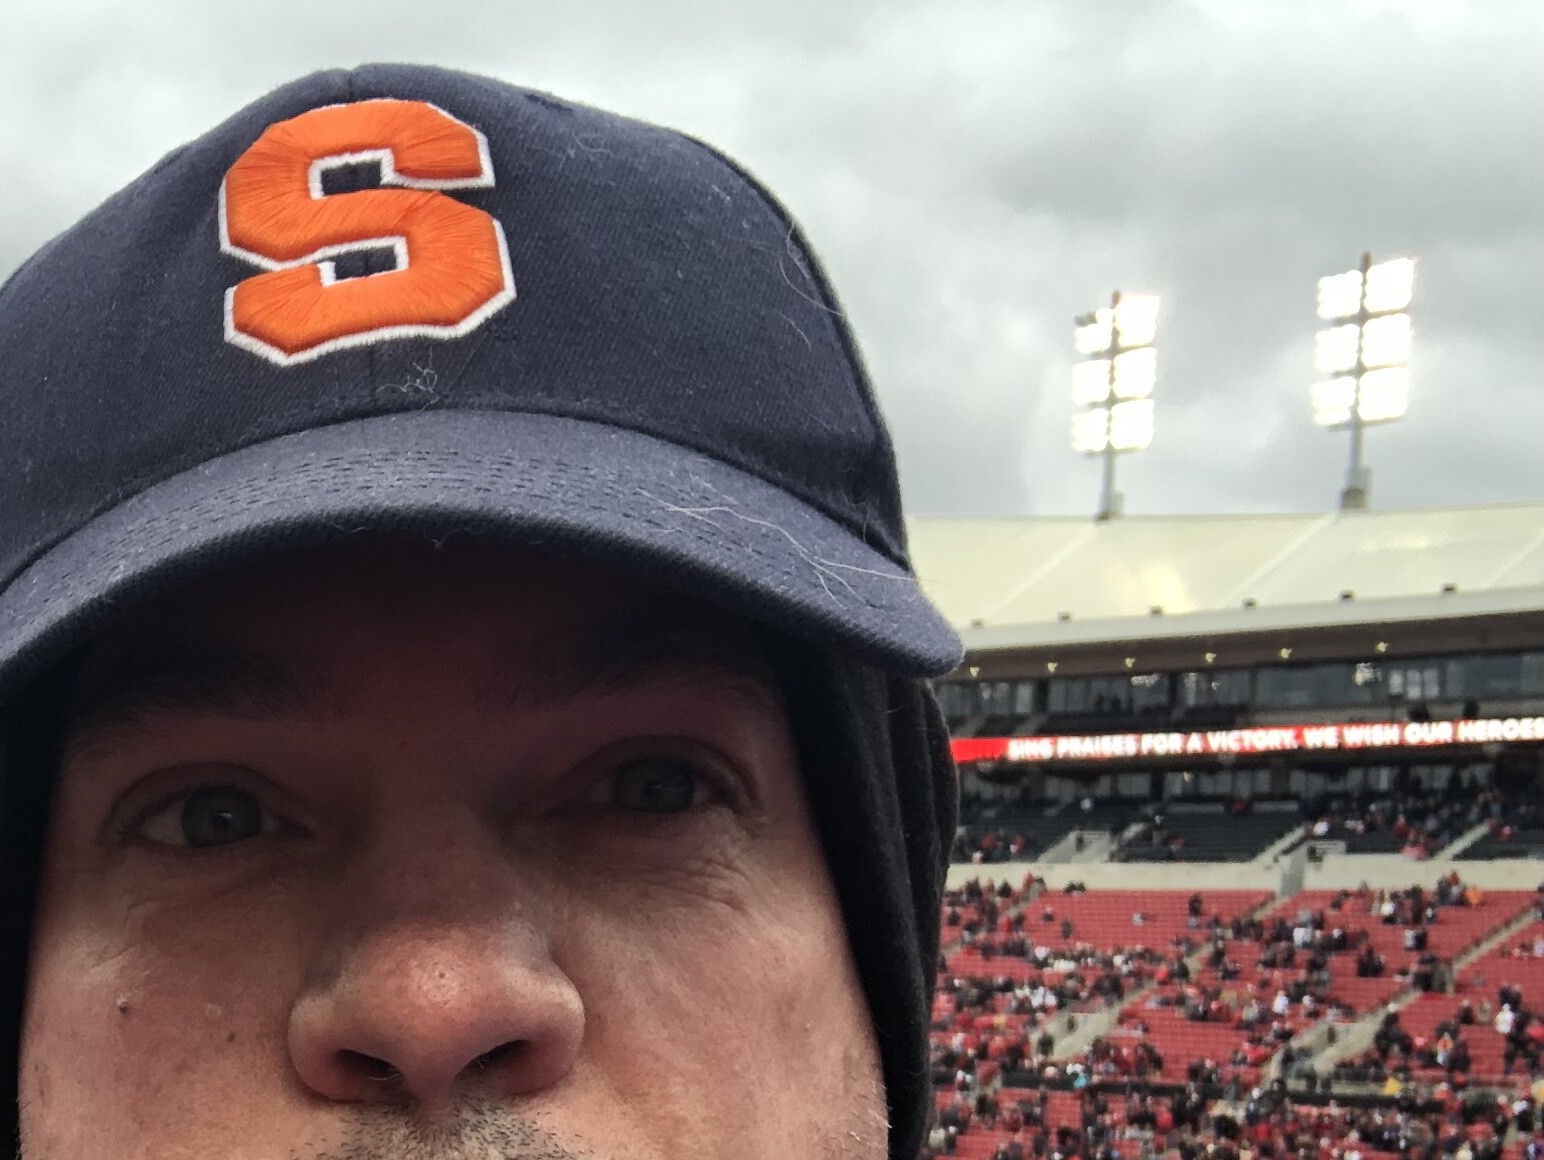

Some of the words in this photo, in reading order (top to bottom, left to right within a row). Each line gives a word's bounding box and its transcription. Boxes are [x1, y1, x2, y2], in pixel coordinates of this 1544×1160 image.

[218, 98, 517, 367] S
[1057, 734, 1137, 759] PRAISES
[1141, 732, 1183, 755] FOR
[1187, 732, 1203, 754] A
[1303, 725, 1339, 749] WE
[1343, 722, 1400, 748] WISH
[1404, 720, 1454, 745] OUR
